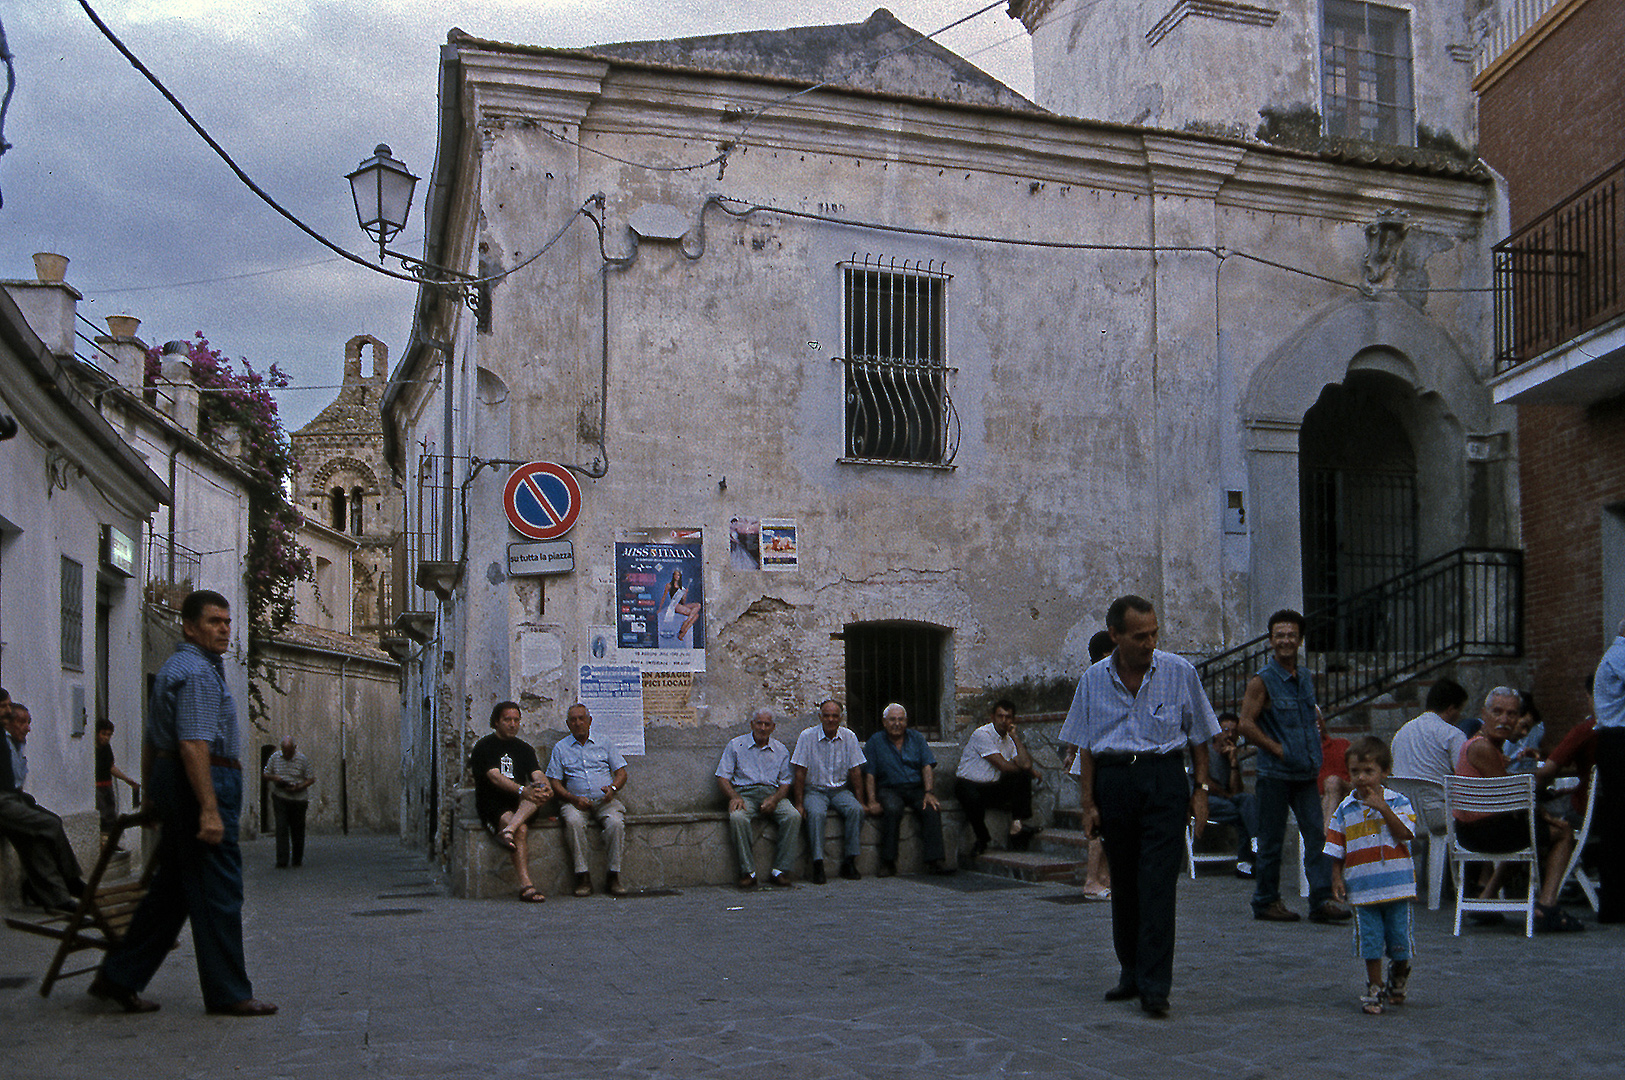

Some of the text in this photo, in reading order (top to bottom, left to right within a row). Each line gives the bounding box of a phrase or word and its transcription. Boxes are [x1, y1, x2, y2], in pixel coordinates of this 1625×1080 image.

[510, 551, 572, 563] su tutta la piazza
[622, 547, 696, 558] MISS ITALIA
[654, 671, 691, 679] ASSAGGI
